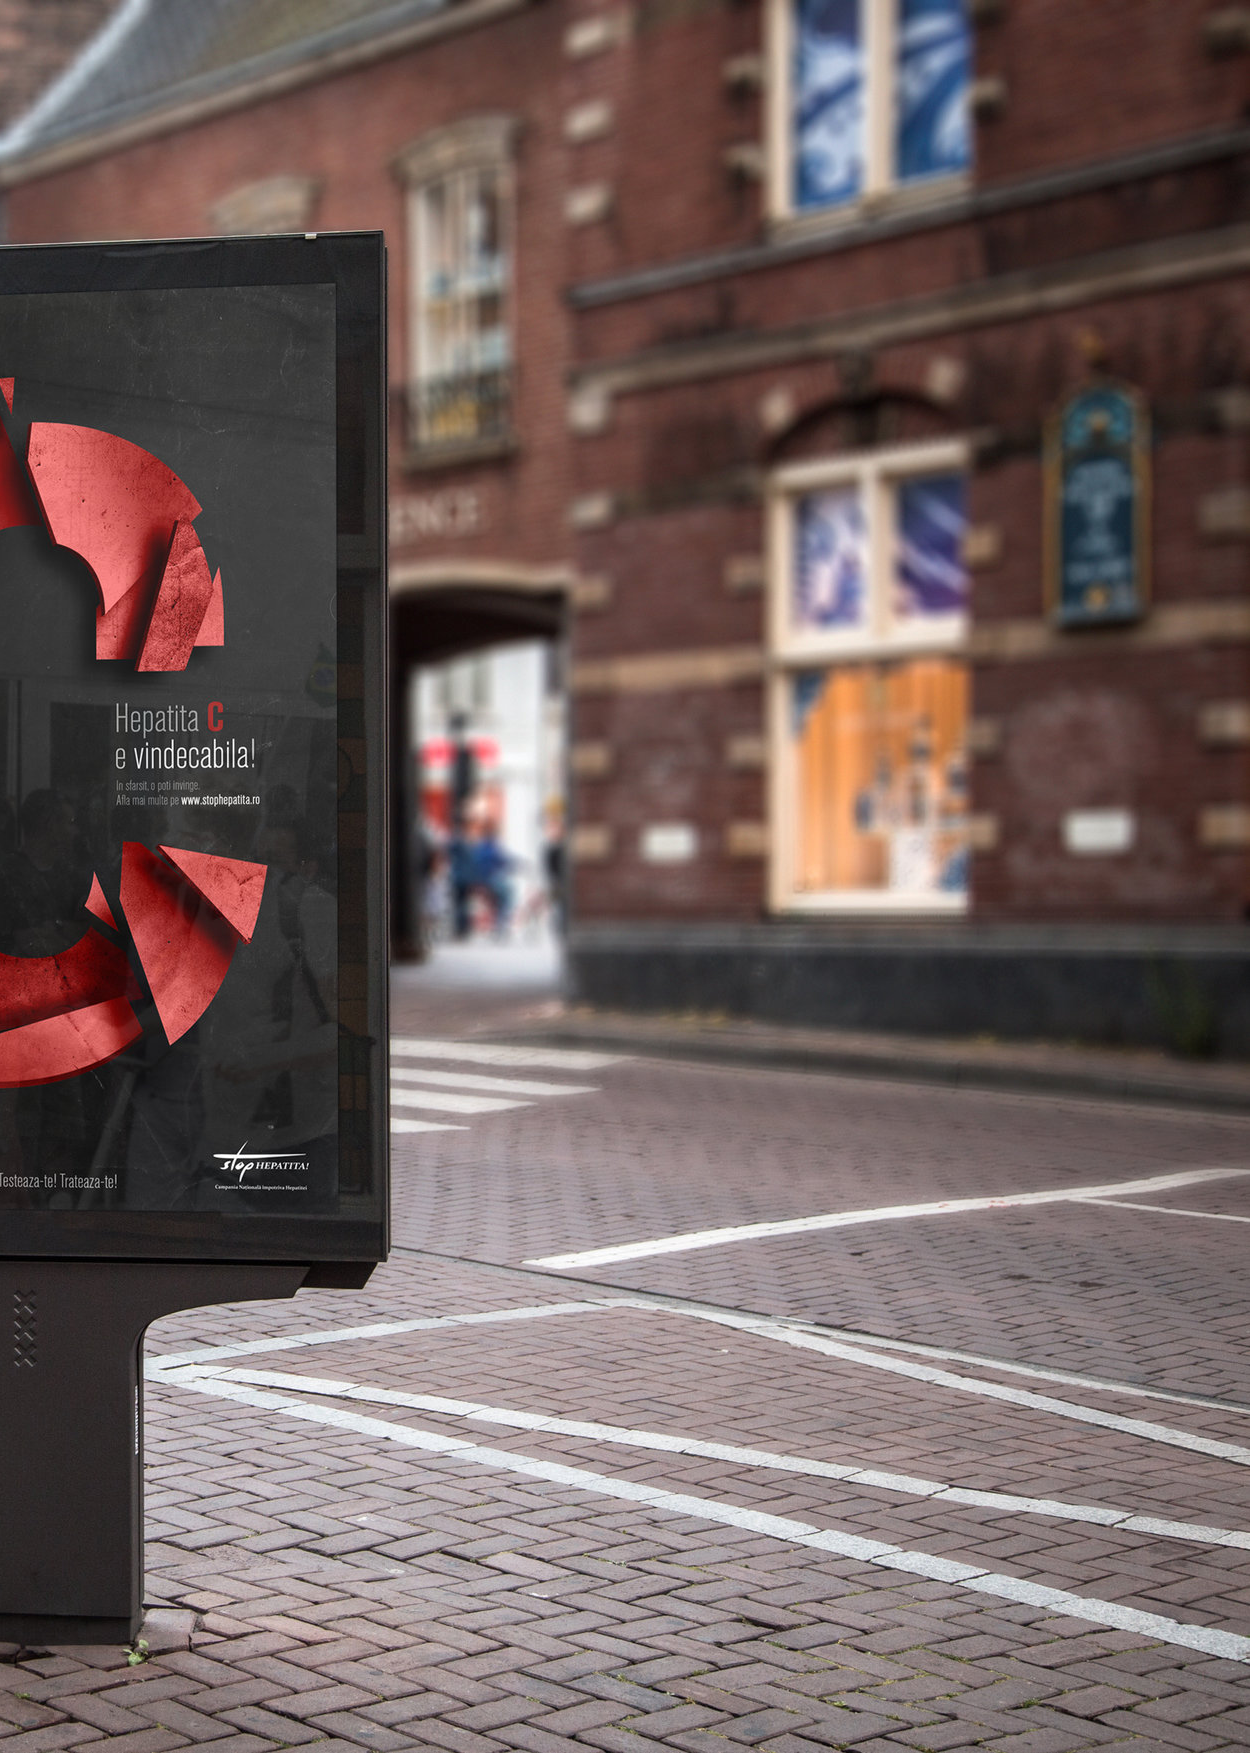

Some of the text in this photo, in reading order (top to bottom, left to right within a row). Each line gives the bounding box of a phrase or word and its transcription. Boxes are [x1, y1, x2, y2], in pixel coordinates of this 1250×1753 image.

[116, 701, 224, 739] Hepatita C
[115, 738, 255, 770] e vindecabila!
[116, 780, 124, 791] In
[173, 781, 200, 793] invinge.
[132, 796, 146, 806] mai
[147, 795, 169, 806] multe
[170, 797, 180, 808] pe
[181, 794, 261, 807] www.stophepatita.ro
[255, 1161, 309, 1170] HEPATITA!
[60, 1173, 118, 1189] Trateaza-te!
